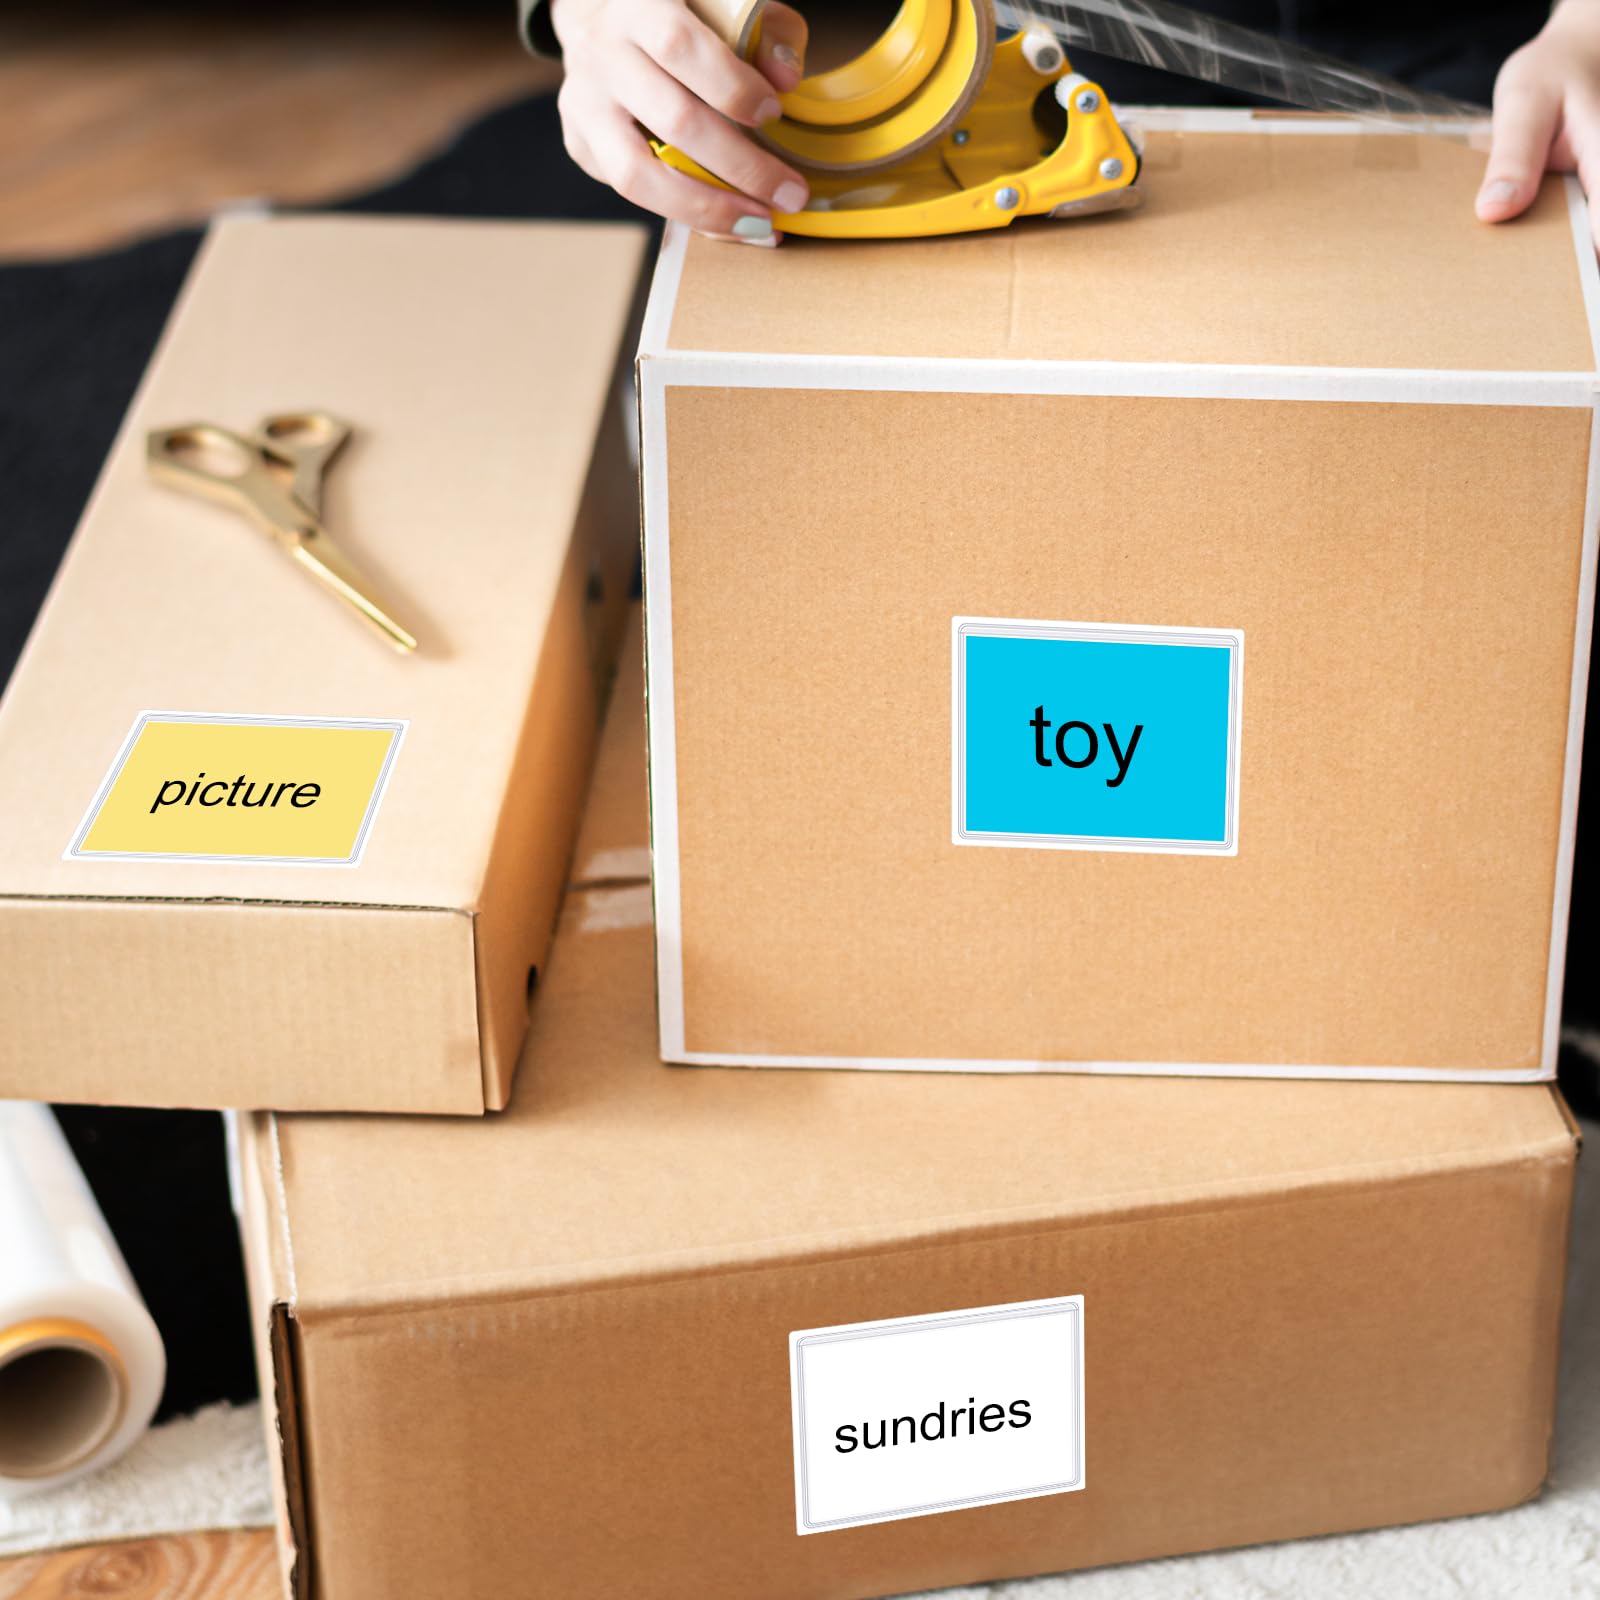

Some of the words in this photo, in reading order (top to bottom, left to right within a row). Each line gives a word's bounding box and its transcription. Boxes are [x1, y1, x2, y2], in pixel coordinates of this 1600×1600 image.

[1029, 705, 1144, 788] toy
[149, 772, 321, 814] picture
[834, 1397, 1032, 1454] sundries
